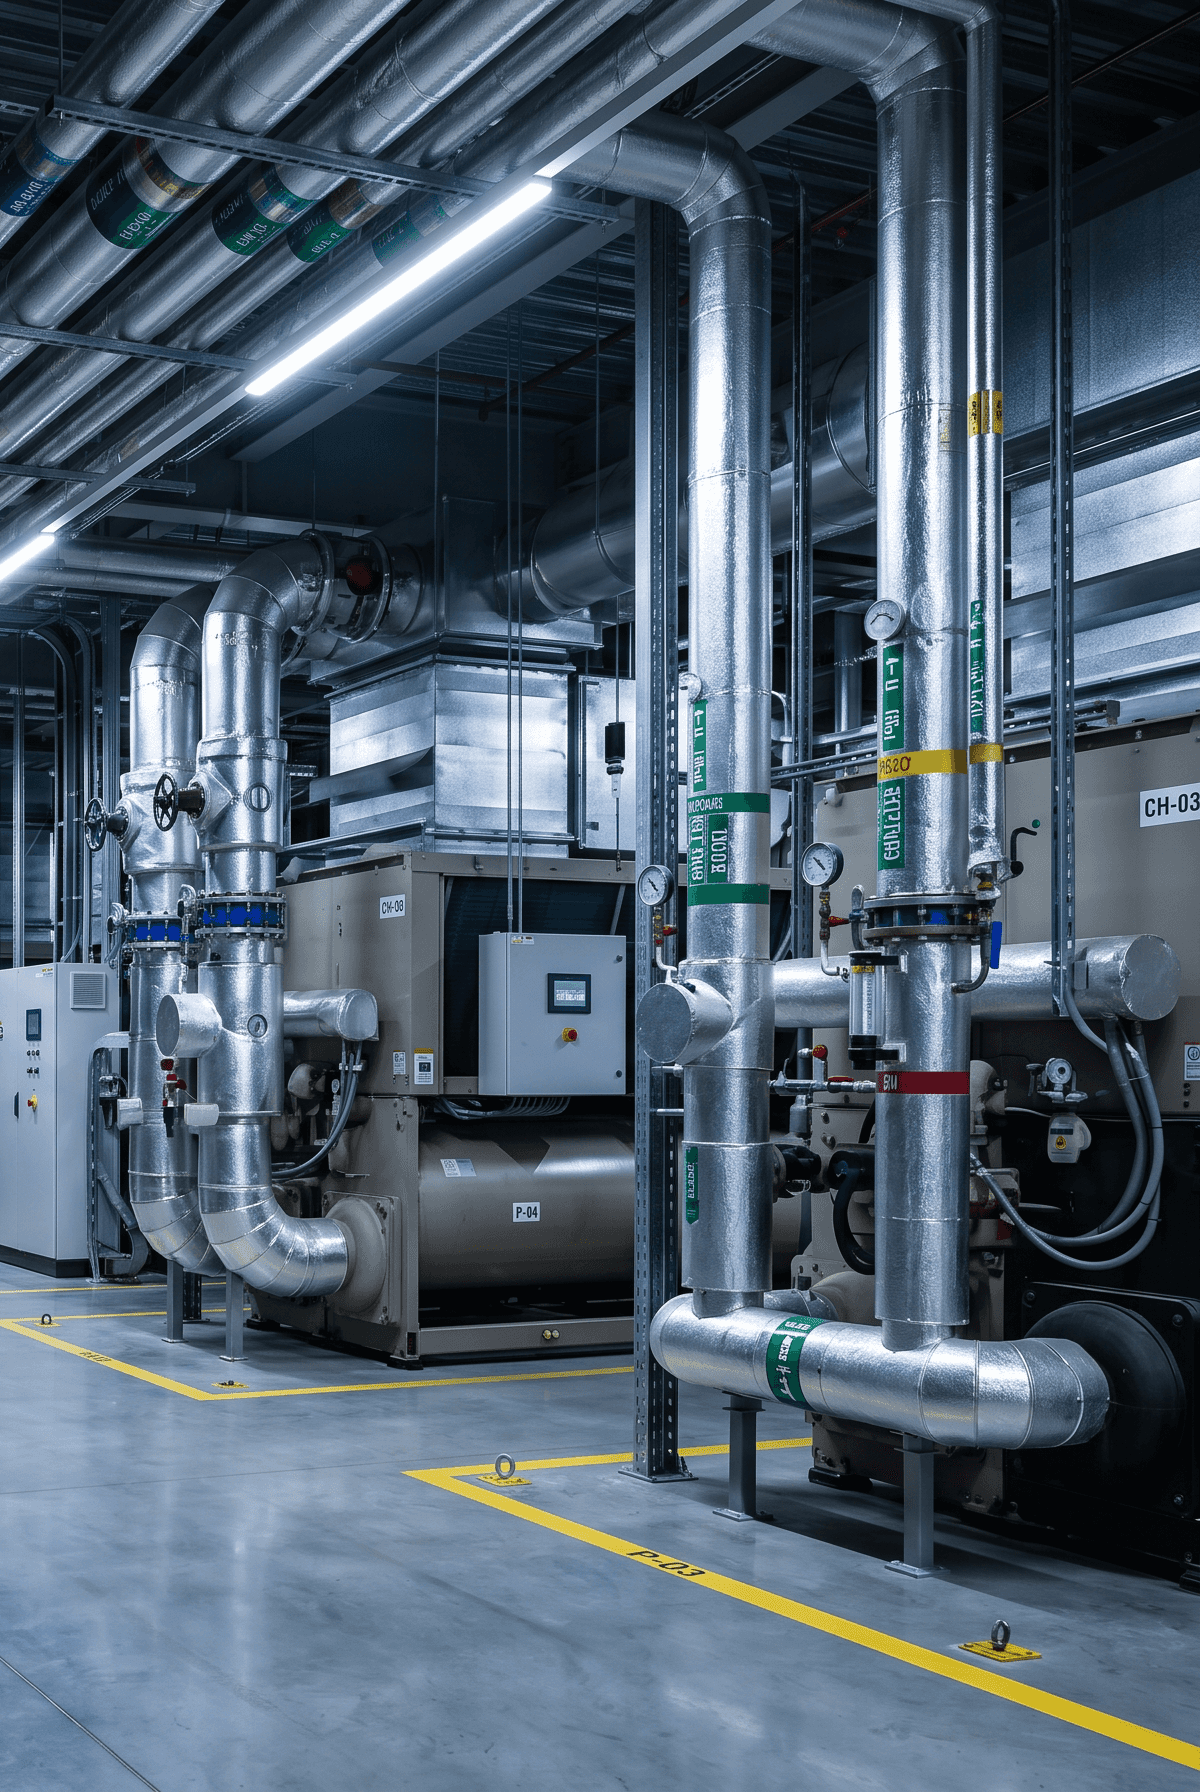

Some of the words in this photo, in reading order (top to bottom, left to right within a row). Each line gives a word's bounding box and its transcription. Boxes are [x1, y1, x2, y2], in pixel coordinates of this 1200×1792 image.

[1145, 792, 1200, 817] CH-03
[516, 1206, 538, 1218] P-04
[626, 1551, 706, 1577] P-03
